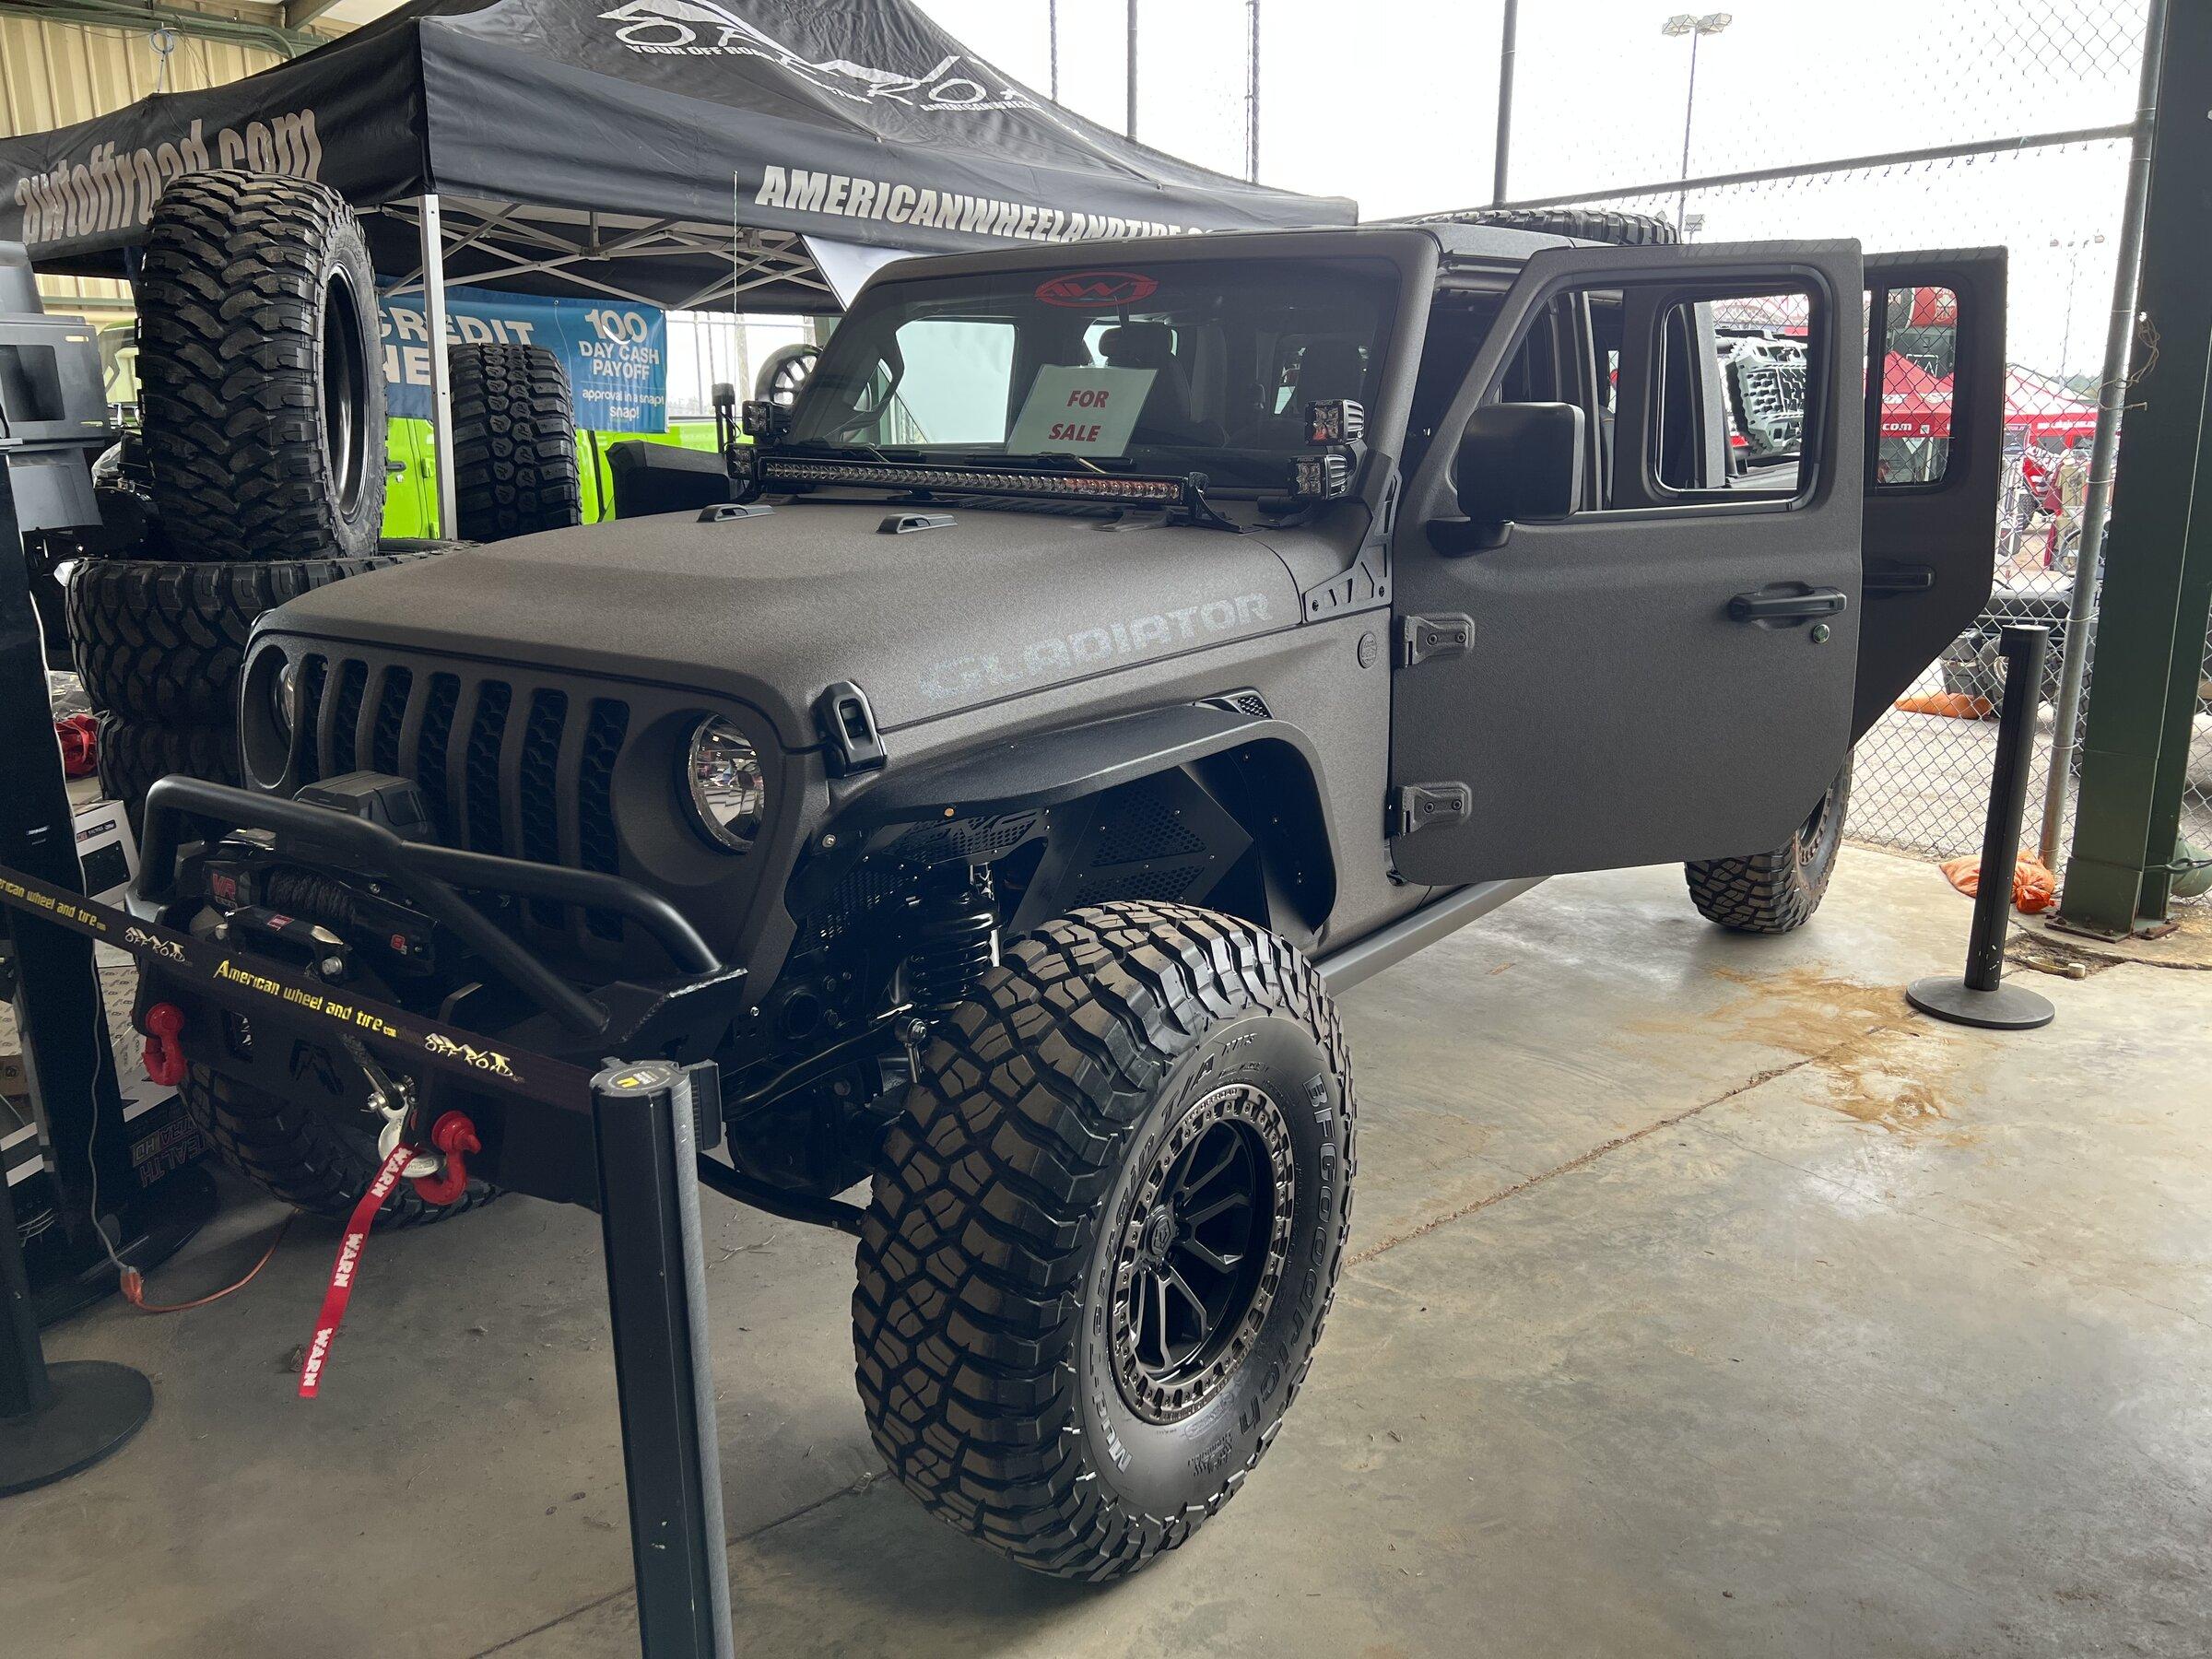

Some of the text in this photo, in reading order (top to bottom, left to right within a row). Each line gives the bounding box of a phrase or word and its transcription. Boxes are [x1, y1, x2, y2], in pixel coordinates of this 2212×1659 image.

[625, 44, 687, 56] YOUR
[686, 46, 724, 56] OFF
[584, 309, 649, 344] 100
[578, 340, 660, 365] DAY CASH
[592, 359, 650, 381] PAYOFF
[582, 388, 623, 402] approval
[624, 391, 632, 402] in
[1066, 390, 1110, 408] FOR
[608, 406, 640, 421] snap!
[1048, 423, 1101, 442] SALE
[922, 592, 1274, 699] GLADIATOR
[26, 889, 56, 911] wheel
[56, 901, 76, 919] and
[77, 909, 98, 927] tire
[213, 959, 281, 996] American
[282, 986, 324, 1011] wheel
[324, 1001, 353, 1021] and
[356, 1009, 383, 1032] tire
[371, 1147, 414, 1198] WARN
[333, 1232, 364, 1288] WARN
[302, 1327, 334, 1387] WARN
